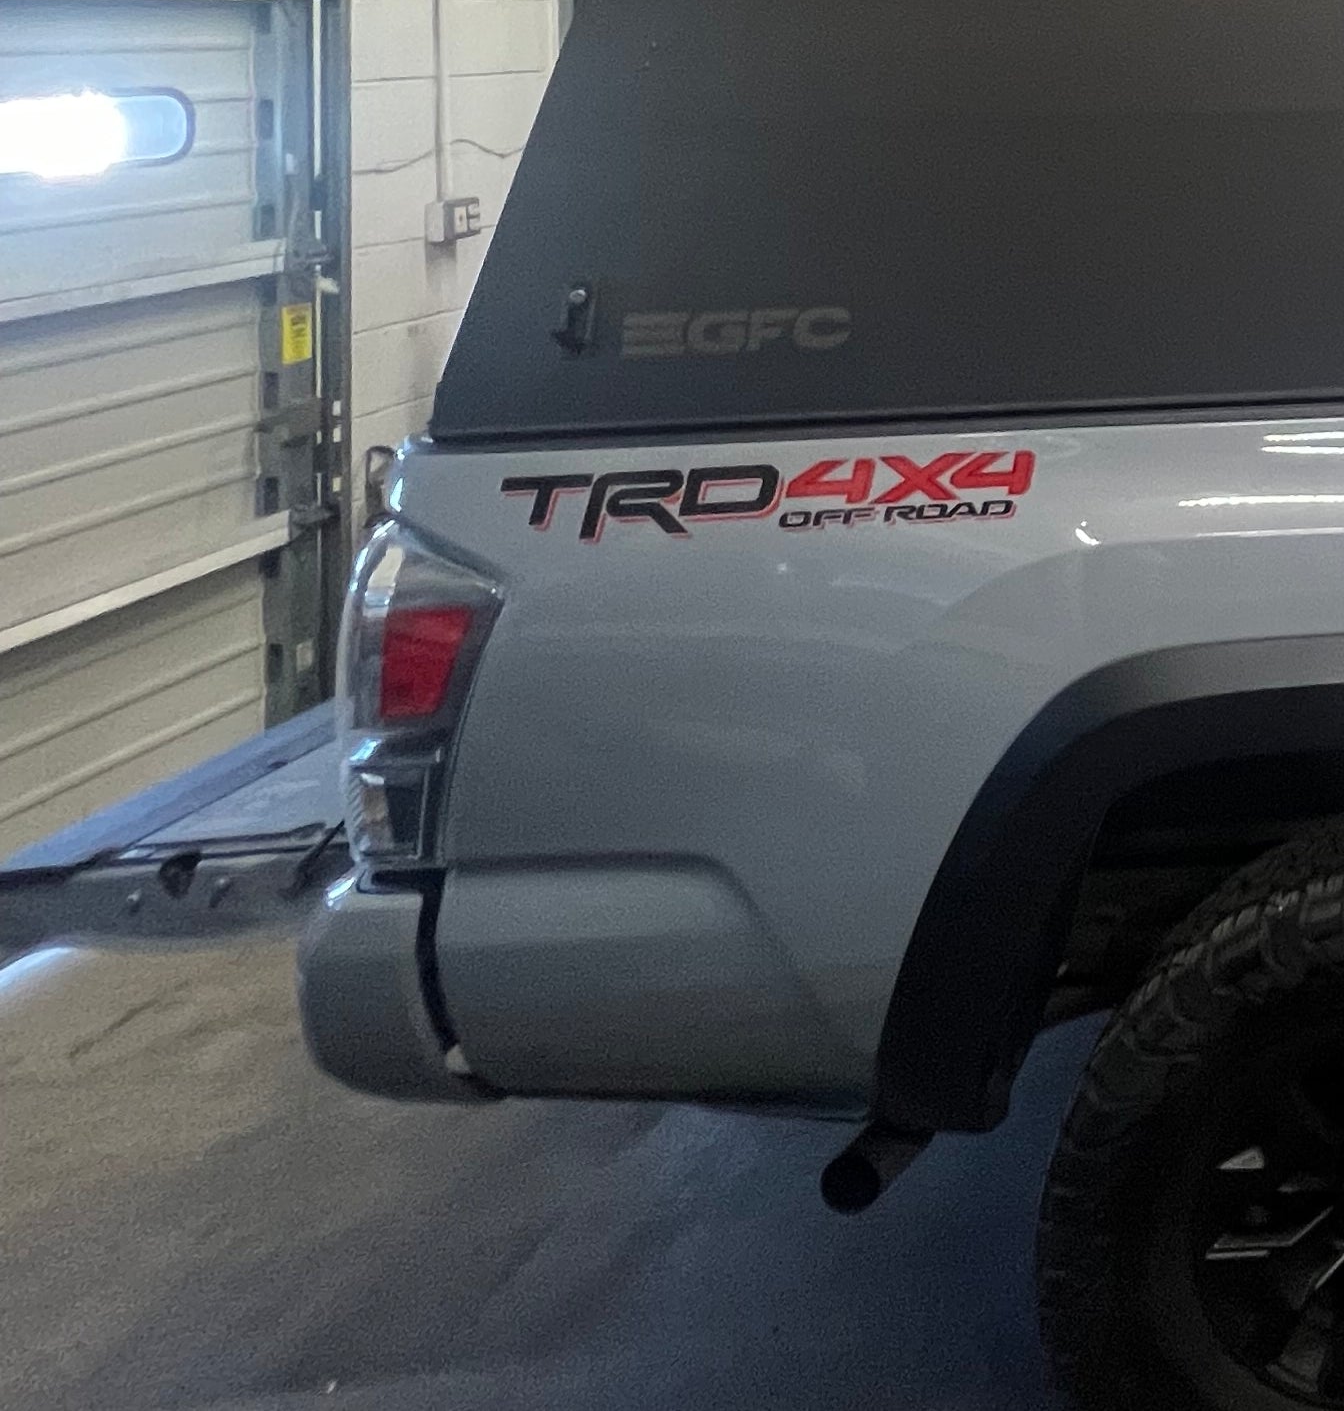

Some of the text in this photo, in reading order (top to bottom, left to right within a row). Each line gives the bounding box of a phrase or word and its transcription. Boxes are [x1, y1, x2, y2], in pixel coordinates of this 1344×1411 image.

[686, 305, 853, 355] GFC
[501, 450, 1036, 542] TRD 4X4
[778, 498, 1017, 530] OFF ROAD
